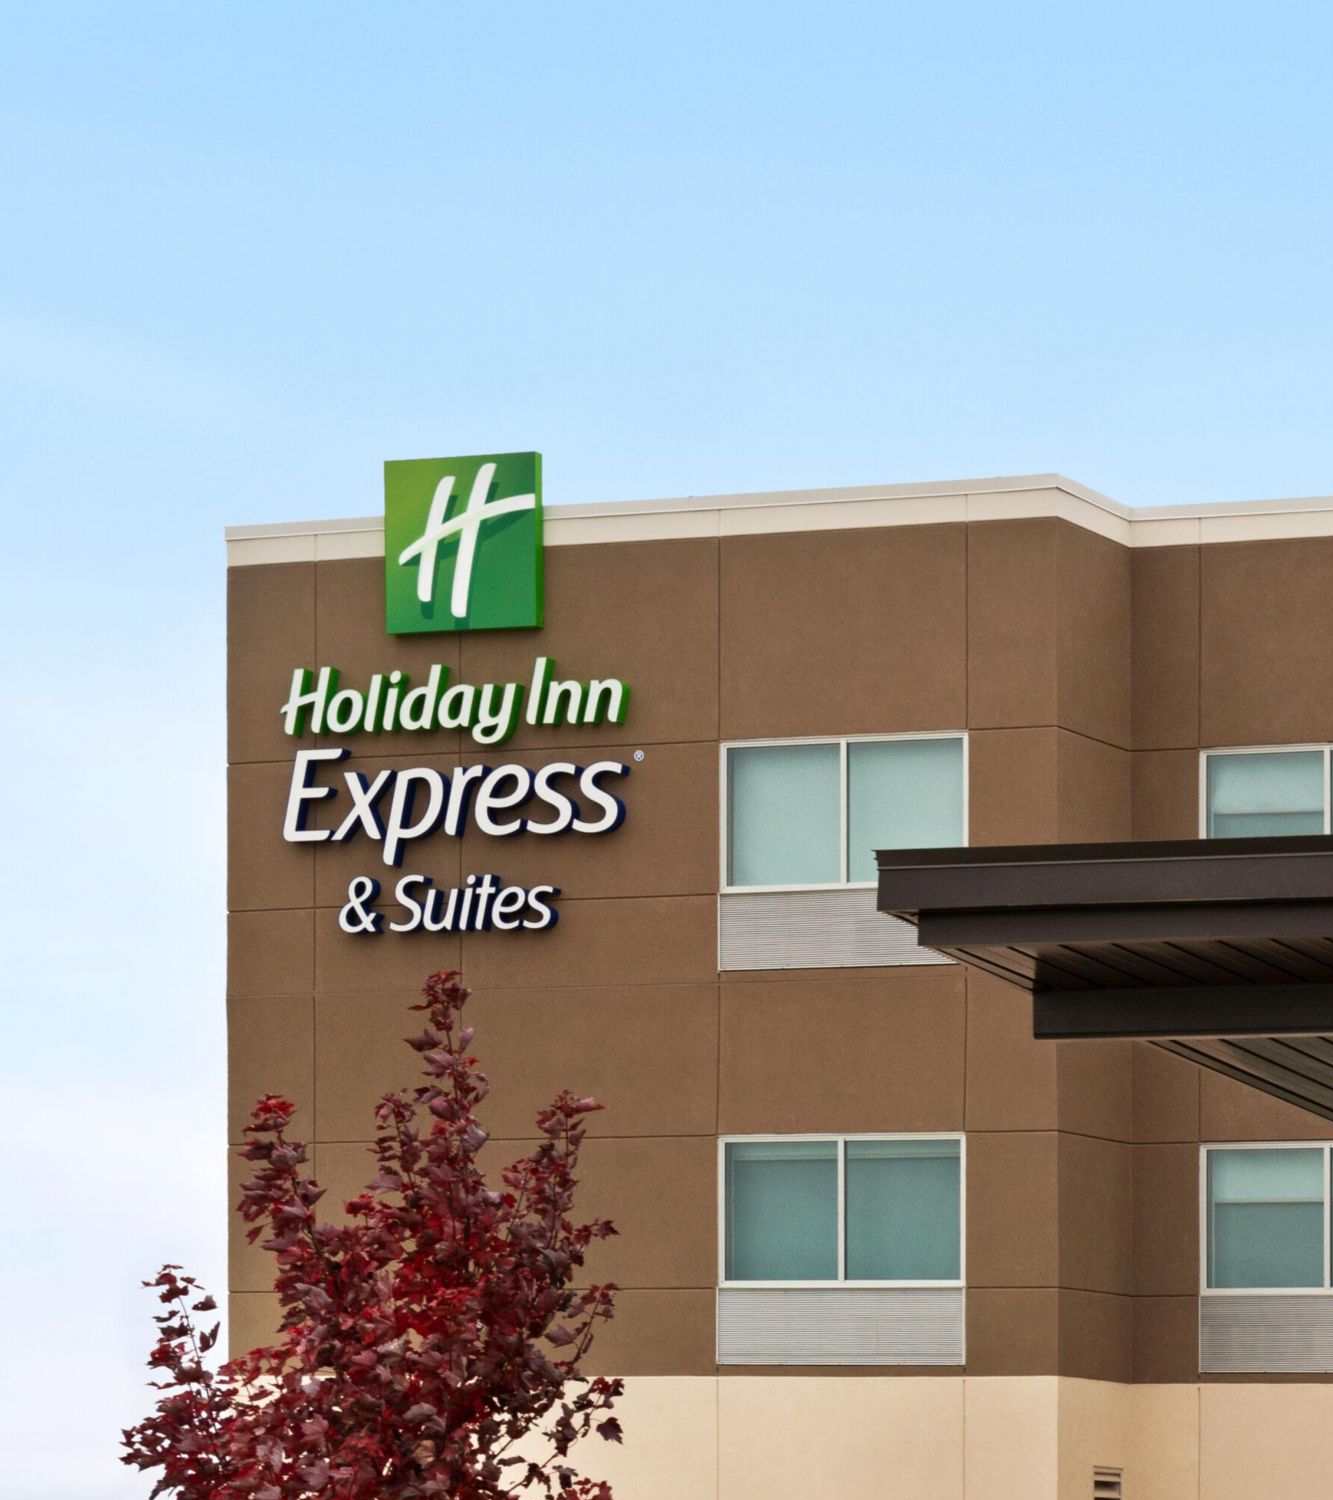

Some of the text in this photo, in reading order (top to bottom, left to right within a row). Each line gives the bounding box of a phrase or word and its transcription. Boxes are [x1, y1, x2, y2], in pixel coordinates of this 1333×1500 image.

[280, 656, 627, 745] Holiday Inn
[282, 747, 627, 867] Express
[338, 873, 558, 935] & Suites
